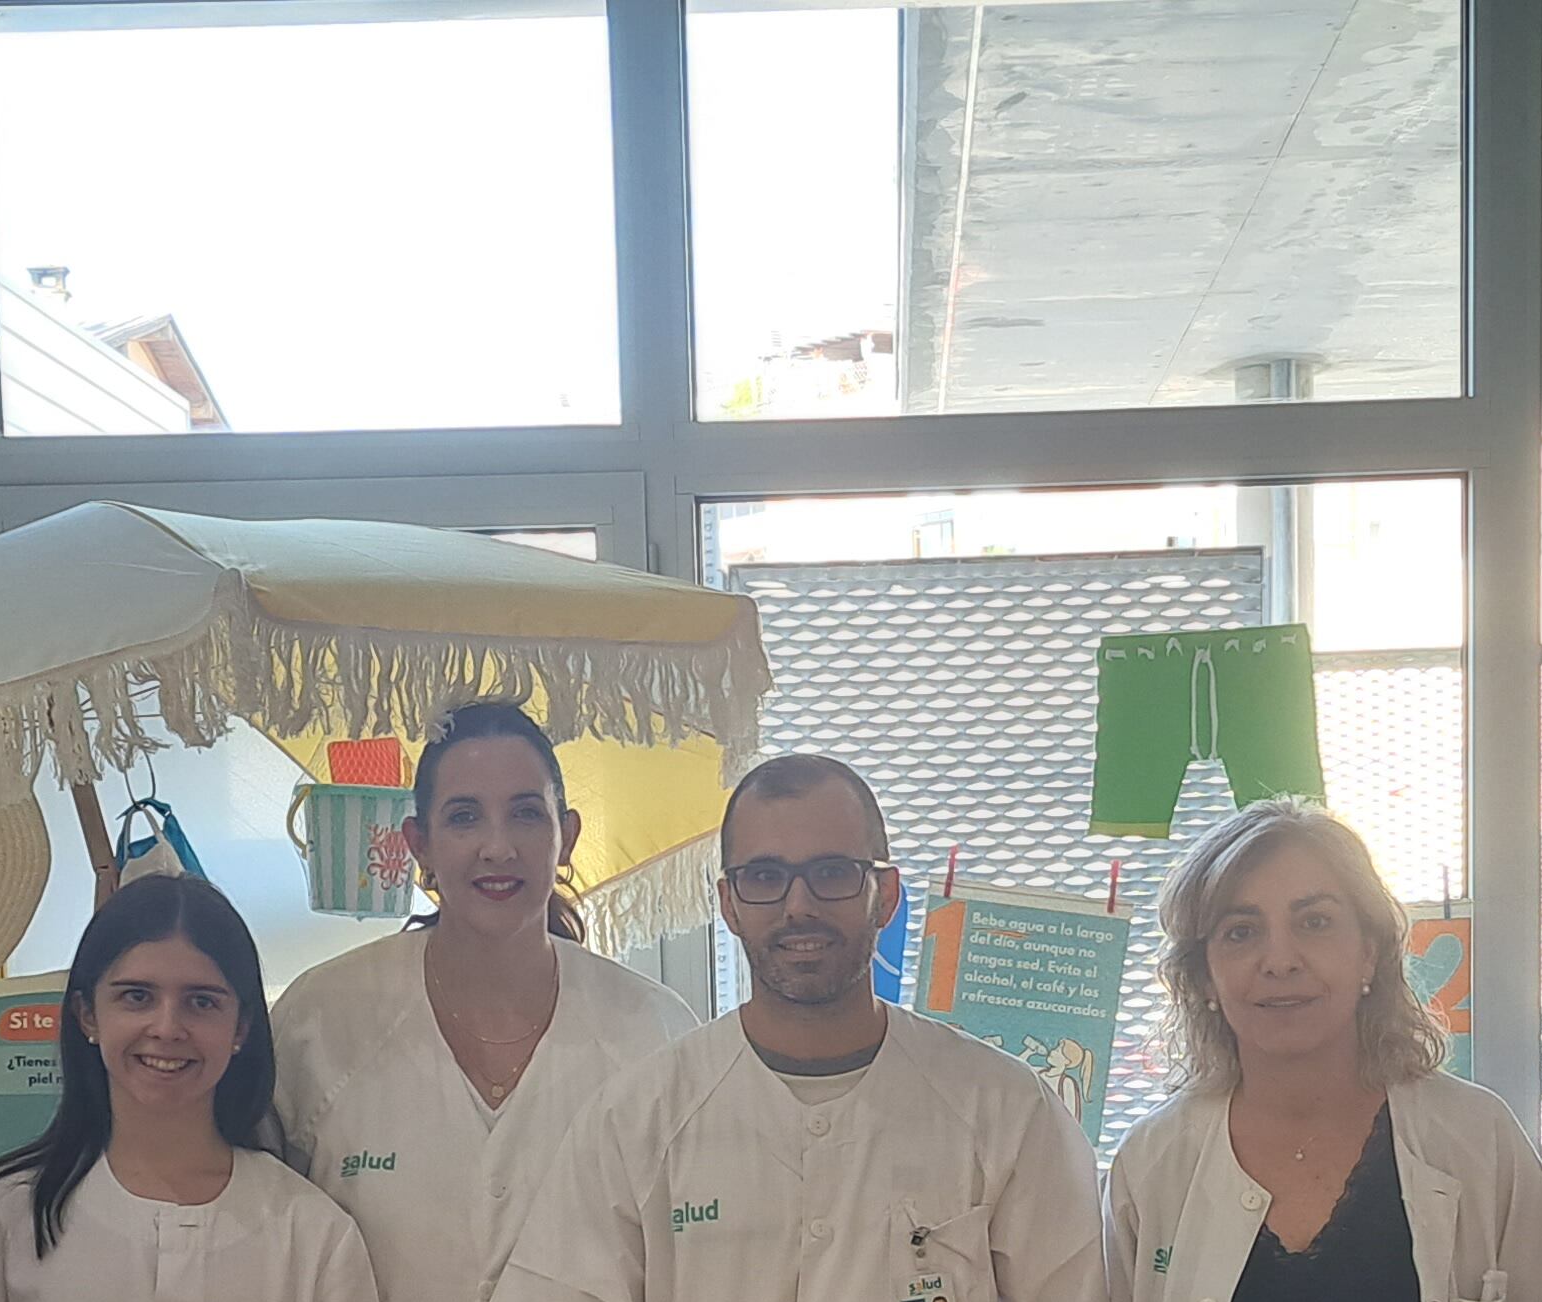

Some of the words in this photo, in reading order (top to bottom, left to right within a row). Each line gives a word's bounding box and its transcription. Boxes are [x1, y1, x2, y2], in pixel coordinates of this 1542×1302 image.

[972, 912, 1006, 928] Bebe
[1008, 917, 1044, 934] agua
[1047, 925, 1057, 934] a
[1060, 922, 1074, 936] lo
[1076, 925, 1114, 943] largo
[925, 900, 966, 1013] 1
[969, 931, 992, 945] del
[994, 933, 1020, 950] día,
[1023, 942, 1076, 959] aunque
[1078, 946, 1097, 959] no
[967, 951, 1014, 969] tengas
[1016, 956, 1045, 972] sed.
[1047, 961, 1081, 977] Evita
[1084, 965, 1097, 979] el
[964, 969, 1018, 989] alcohol,
[1021, 977, 1033, 991] el
[1036, 980, 1066, 996] café
[1068, 985, 1077, 998] y
[1079, 983, 1100, 998] los
[961, 990, 1024, 1008] refrescos
[1026, 1000, 1108, 1019] azucarados
[9, 1011, 28, 1029] Si
[33, 1013, 54, 1028] te
[28, 1072, 53, 1087] piel
[341, 1150, 396, 1171] salud
[672, 1198, 719, 1223] alud
